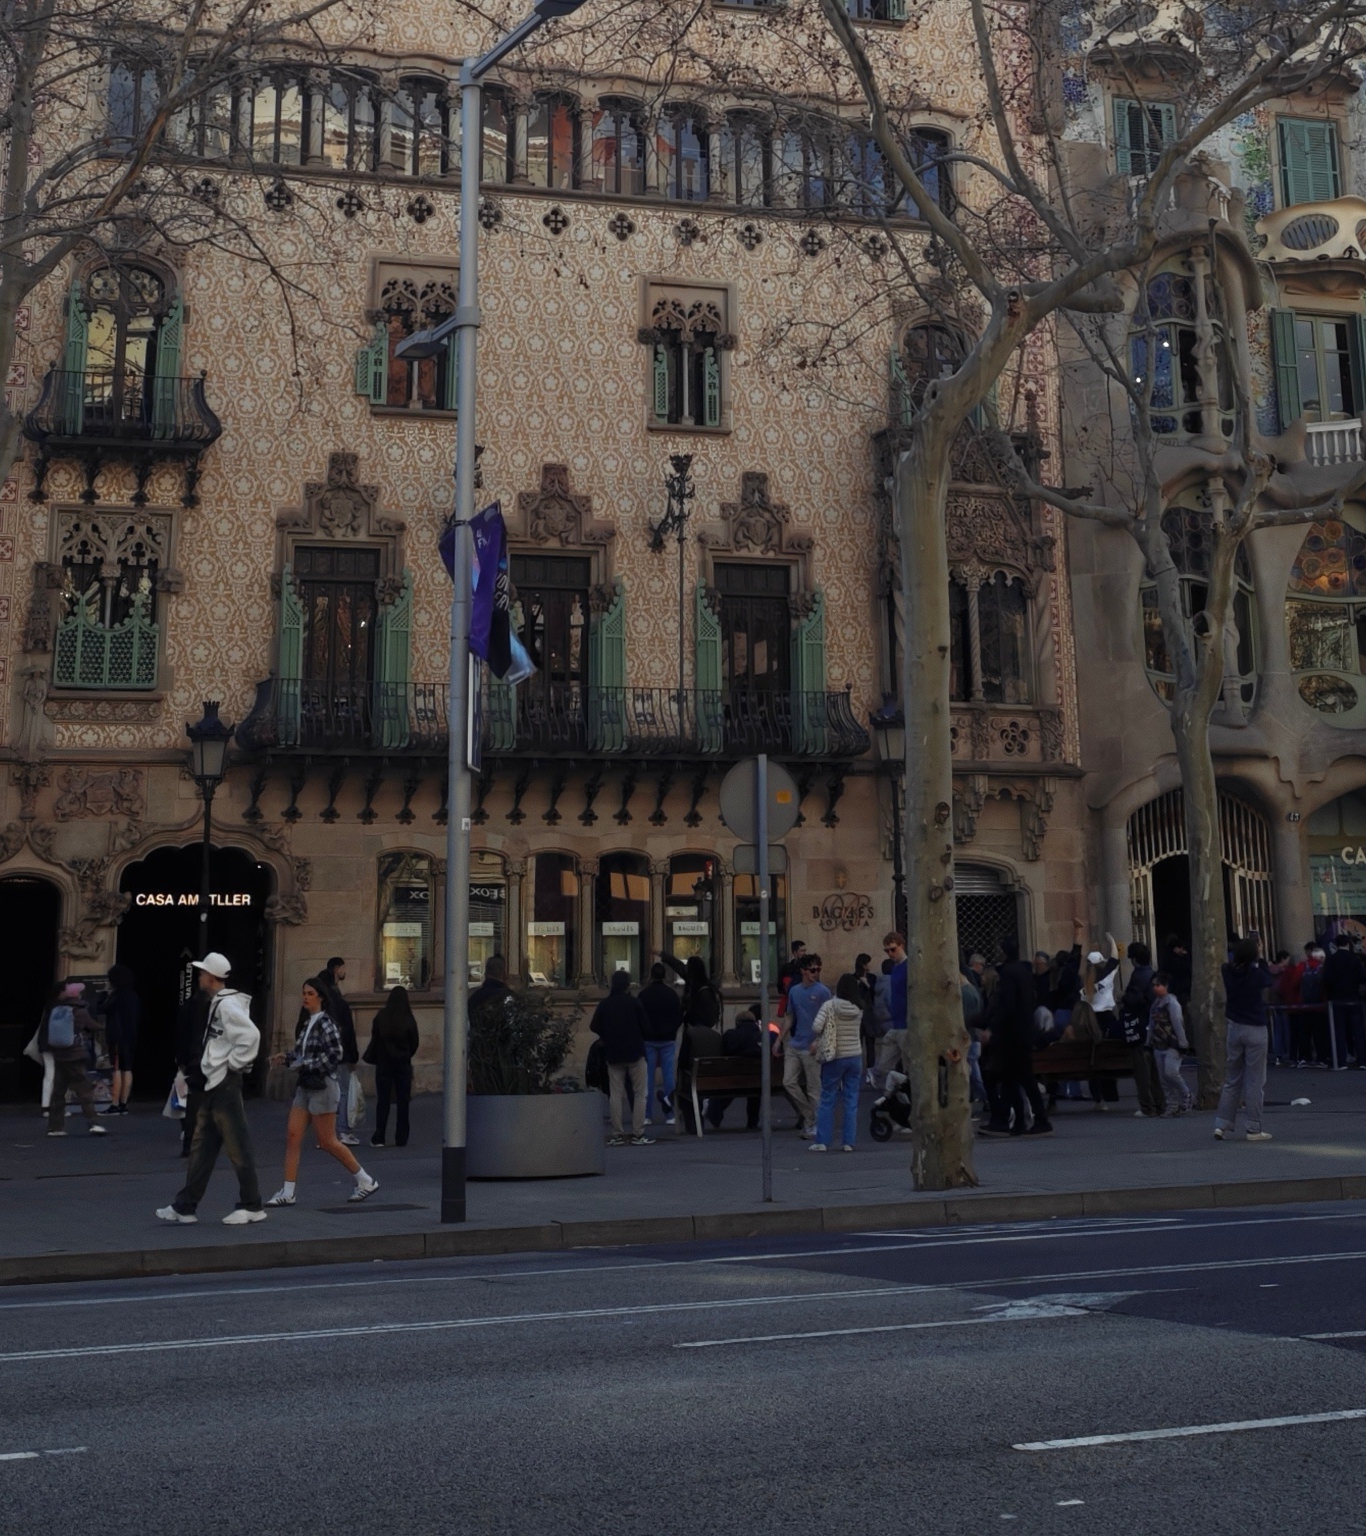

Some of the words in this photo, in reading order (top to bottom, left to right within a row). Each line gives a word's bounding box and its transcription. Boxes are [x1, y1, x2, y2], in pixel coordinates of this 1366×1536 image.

[135, 893, 175, 906] CASA
[177, 893, 252, 906] AMTLLER
[185, 962, 193, 1000] MATLLER
